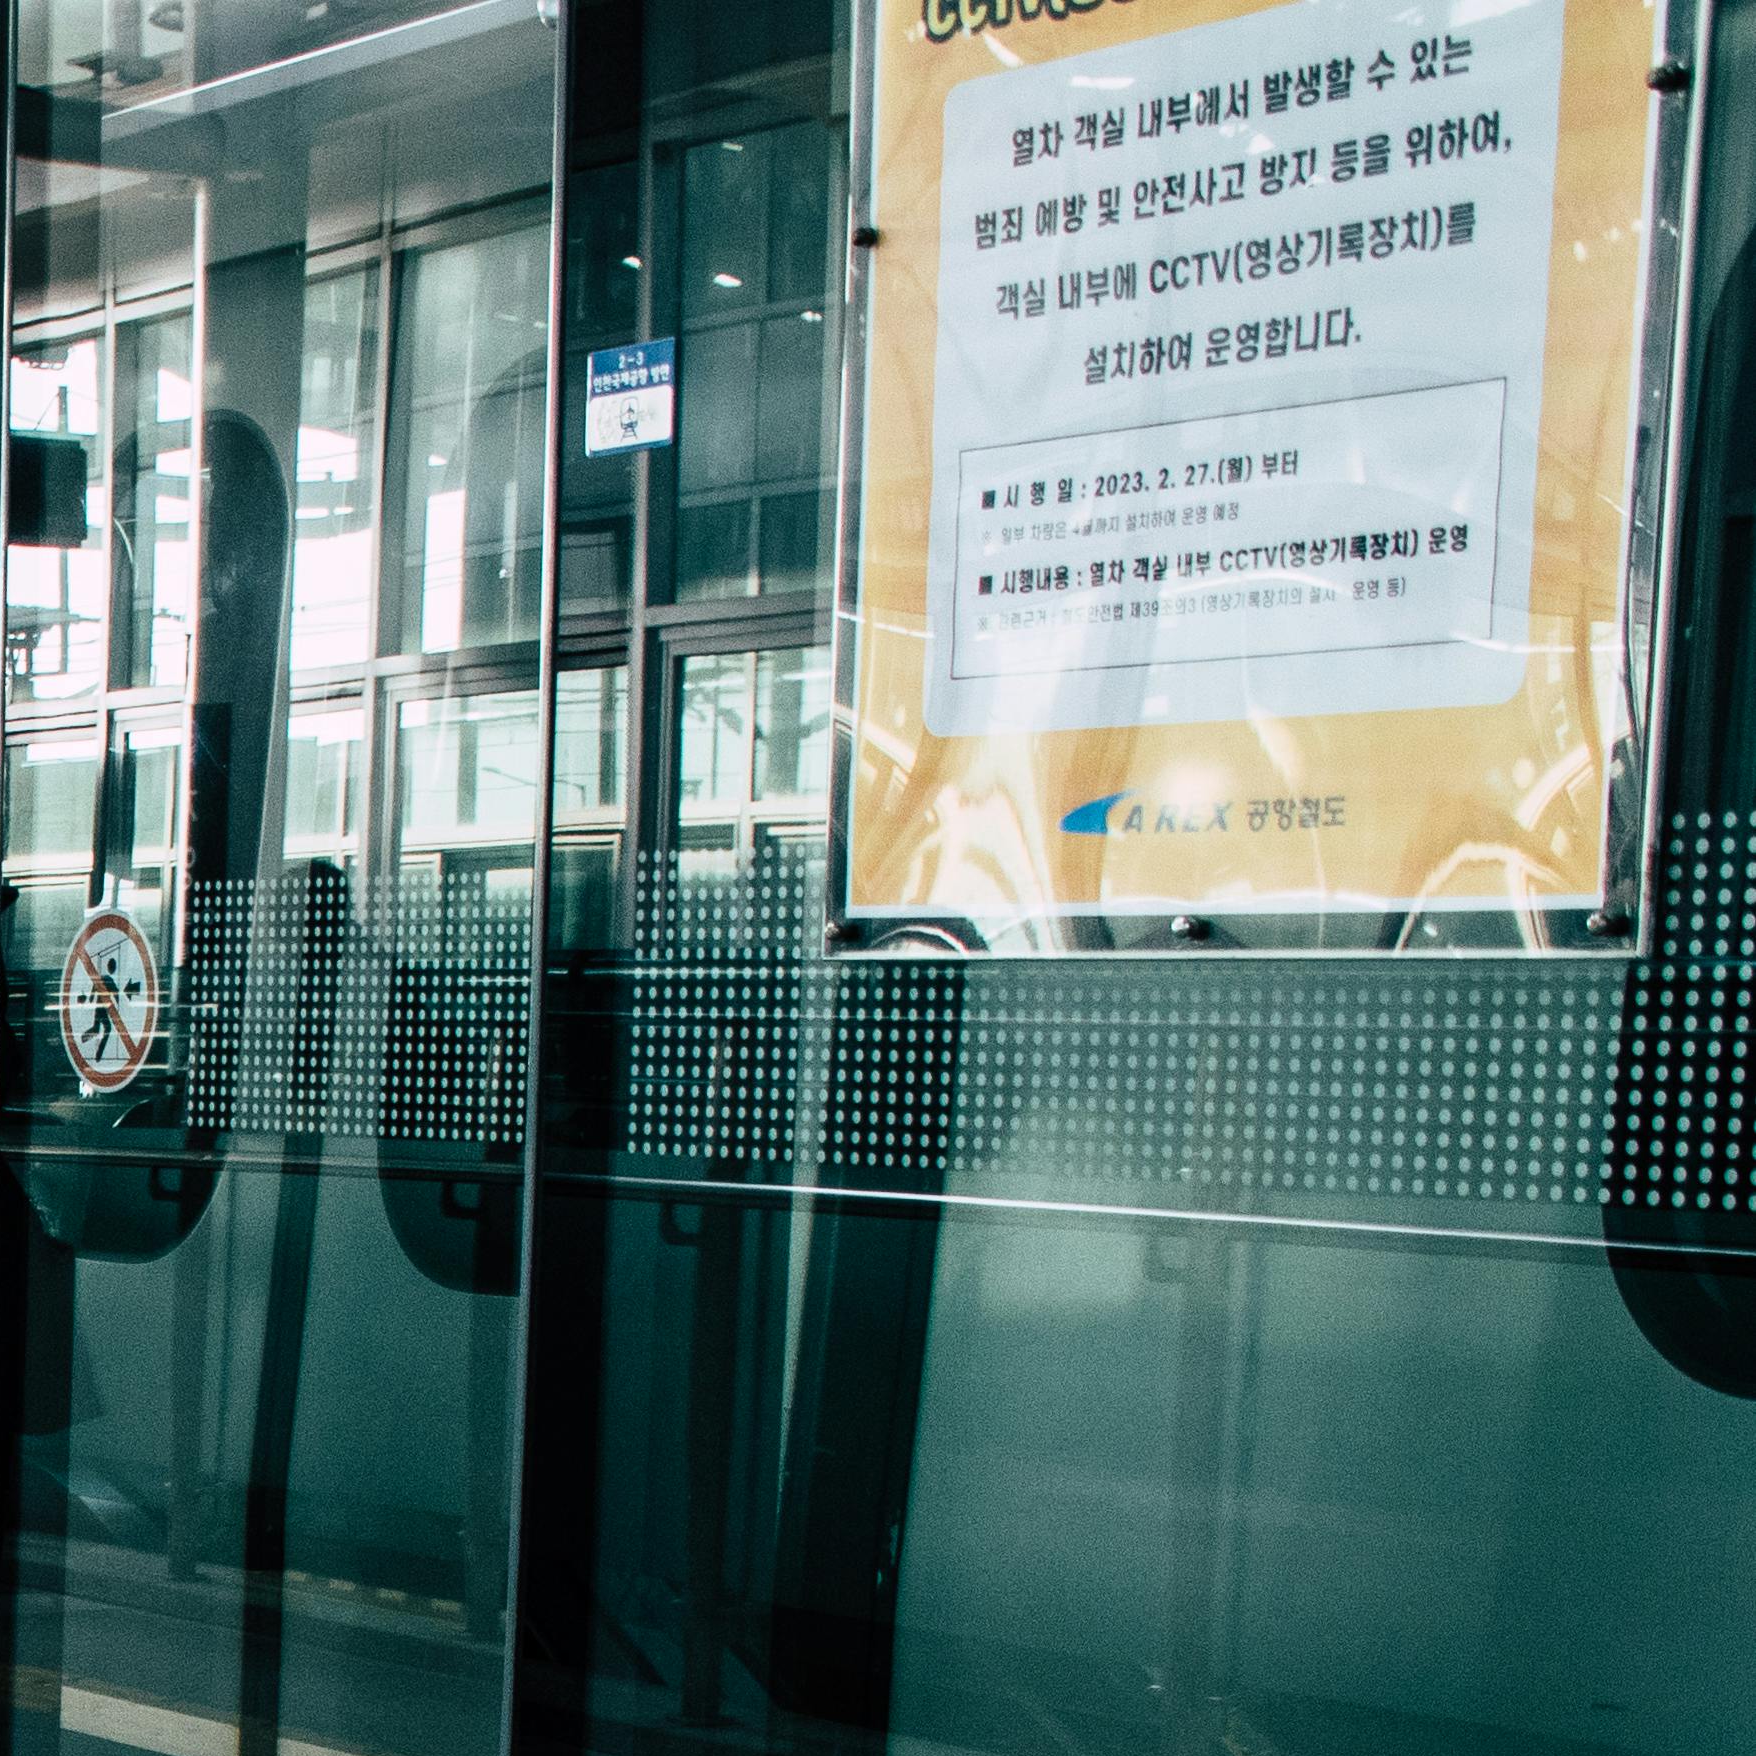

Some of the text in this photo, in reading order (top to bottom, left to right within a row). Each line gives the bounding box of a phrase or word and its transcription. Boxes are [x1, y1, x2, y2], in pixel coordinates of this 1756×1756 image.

[1013, 34, 1473, 168] 열차 객실 내부에서 발생할 수 있는
[975, 109, 1512, 251] 범죄 예방 및 안전사고 방지 등을 위하여,
[996, 201, 1476, 321] 객실 내부에 CCTV(영상기록장치)를
[1084, 306, 1362, 386] 설치하여 운영합니다.
[1093, 471, 1151, 498] 2023.
[1157, 467, 1176, 491] 2.
[1261, 450, 1299, 480] 부터
[1000, 564, 1069, 594] 시행내용
[1089, 558, 1125, 588] 열차
[1133, 555, 1168, 583] 객실
[1176, 550, 1211, 579] 내부
[1219, 529, 1419, 573] CCTV(영상기록장치)
[1429, 523, 1469, 555] 운영
[1247, 795, 1346, 832] 공항철도
